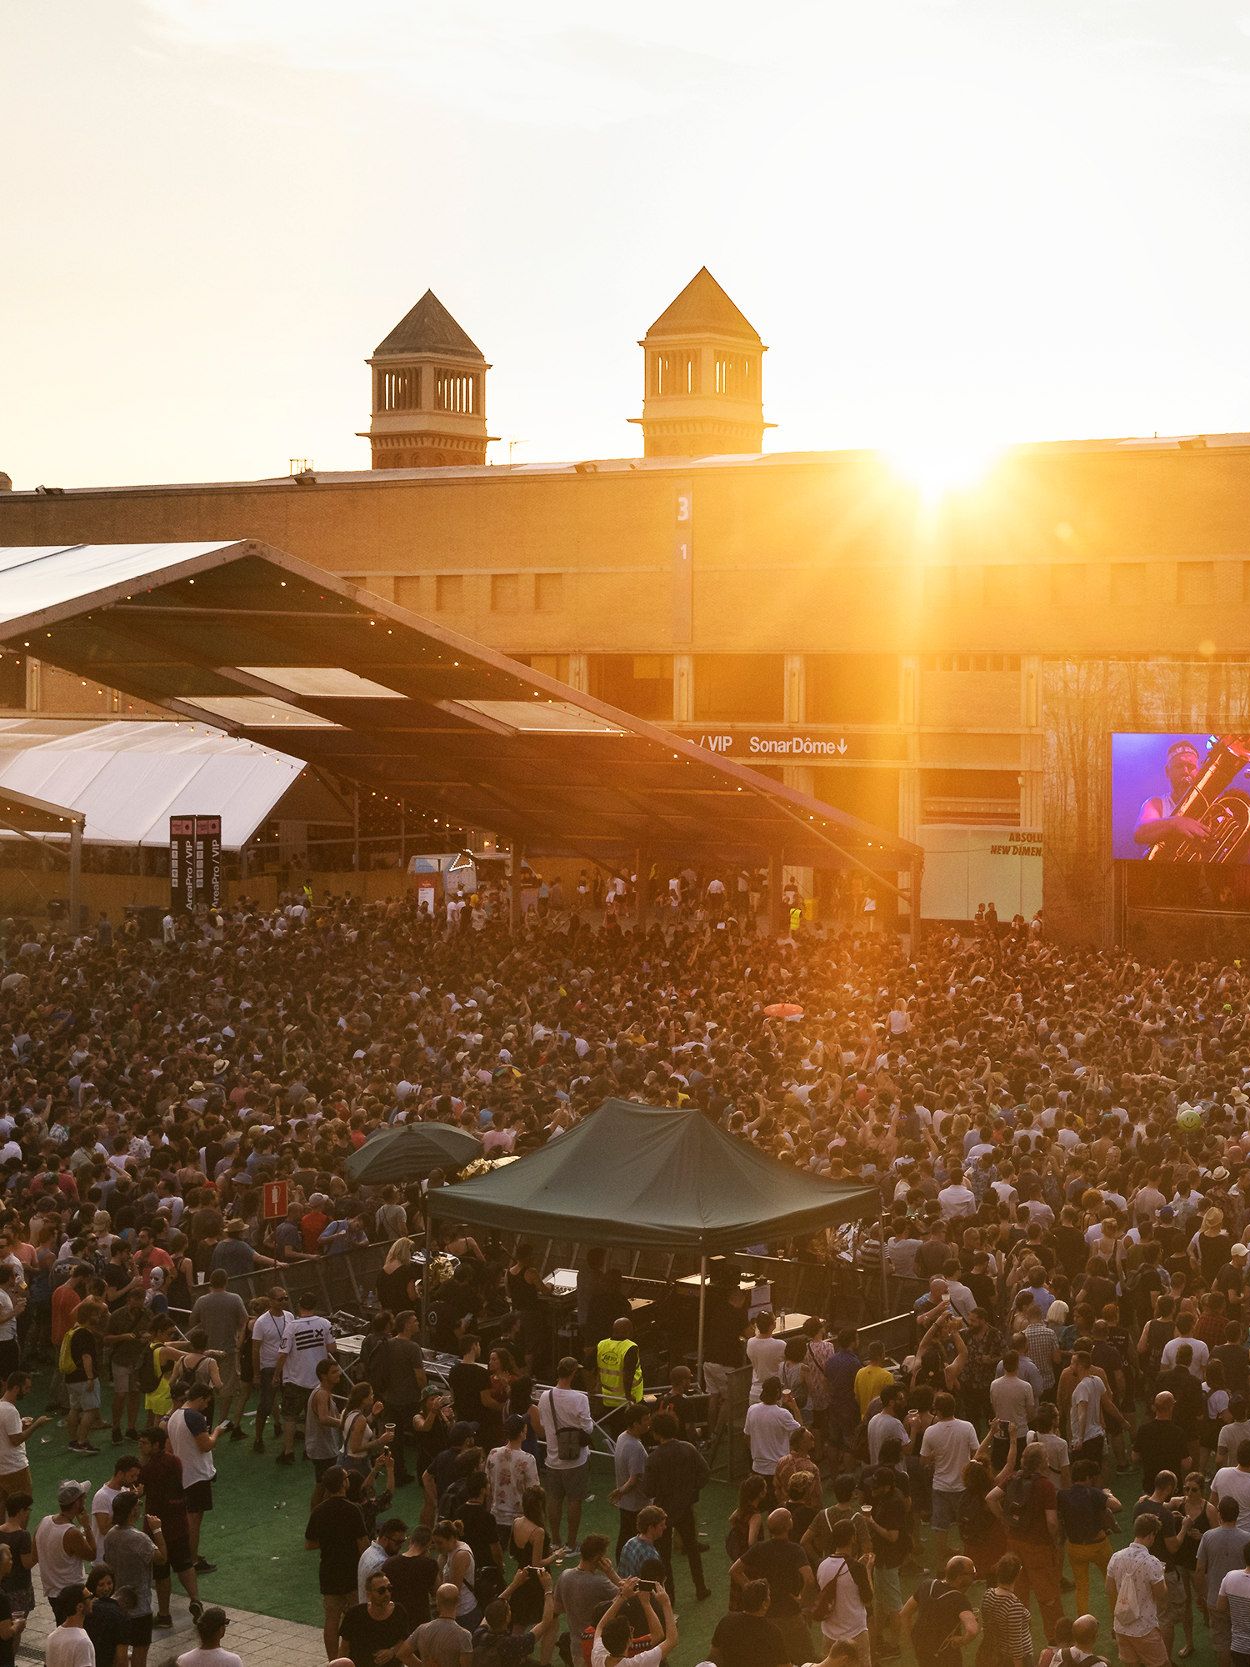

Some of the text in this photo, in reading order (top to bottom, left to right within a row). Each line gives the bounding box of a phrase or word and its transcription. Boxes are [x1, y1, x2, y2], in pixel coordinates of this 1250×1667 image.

[677, 496, 689, 521] 3
[680, 543, 688, 560] 1
[707, 735, 733, 752] VIP
[749, 736, 836, 754] SonarDôme
[185, 840, 194, 859] VIP
[211, 839, 220, 858] VIP
[990, 844, 1011, 855] NEW
[185, 866, 194, 911] AreaPro
